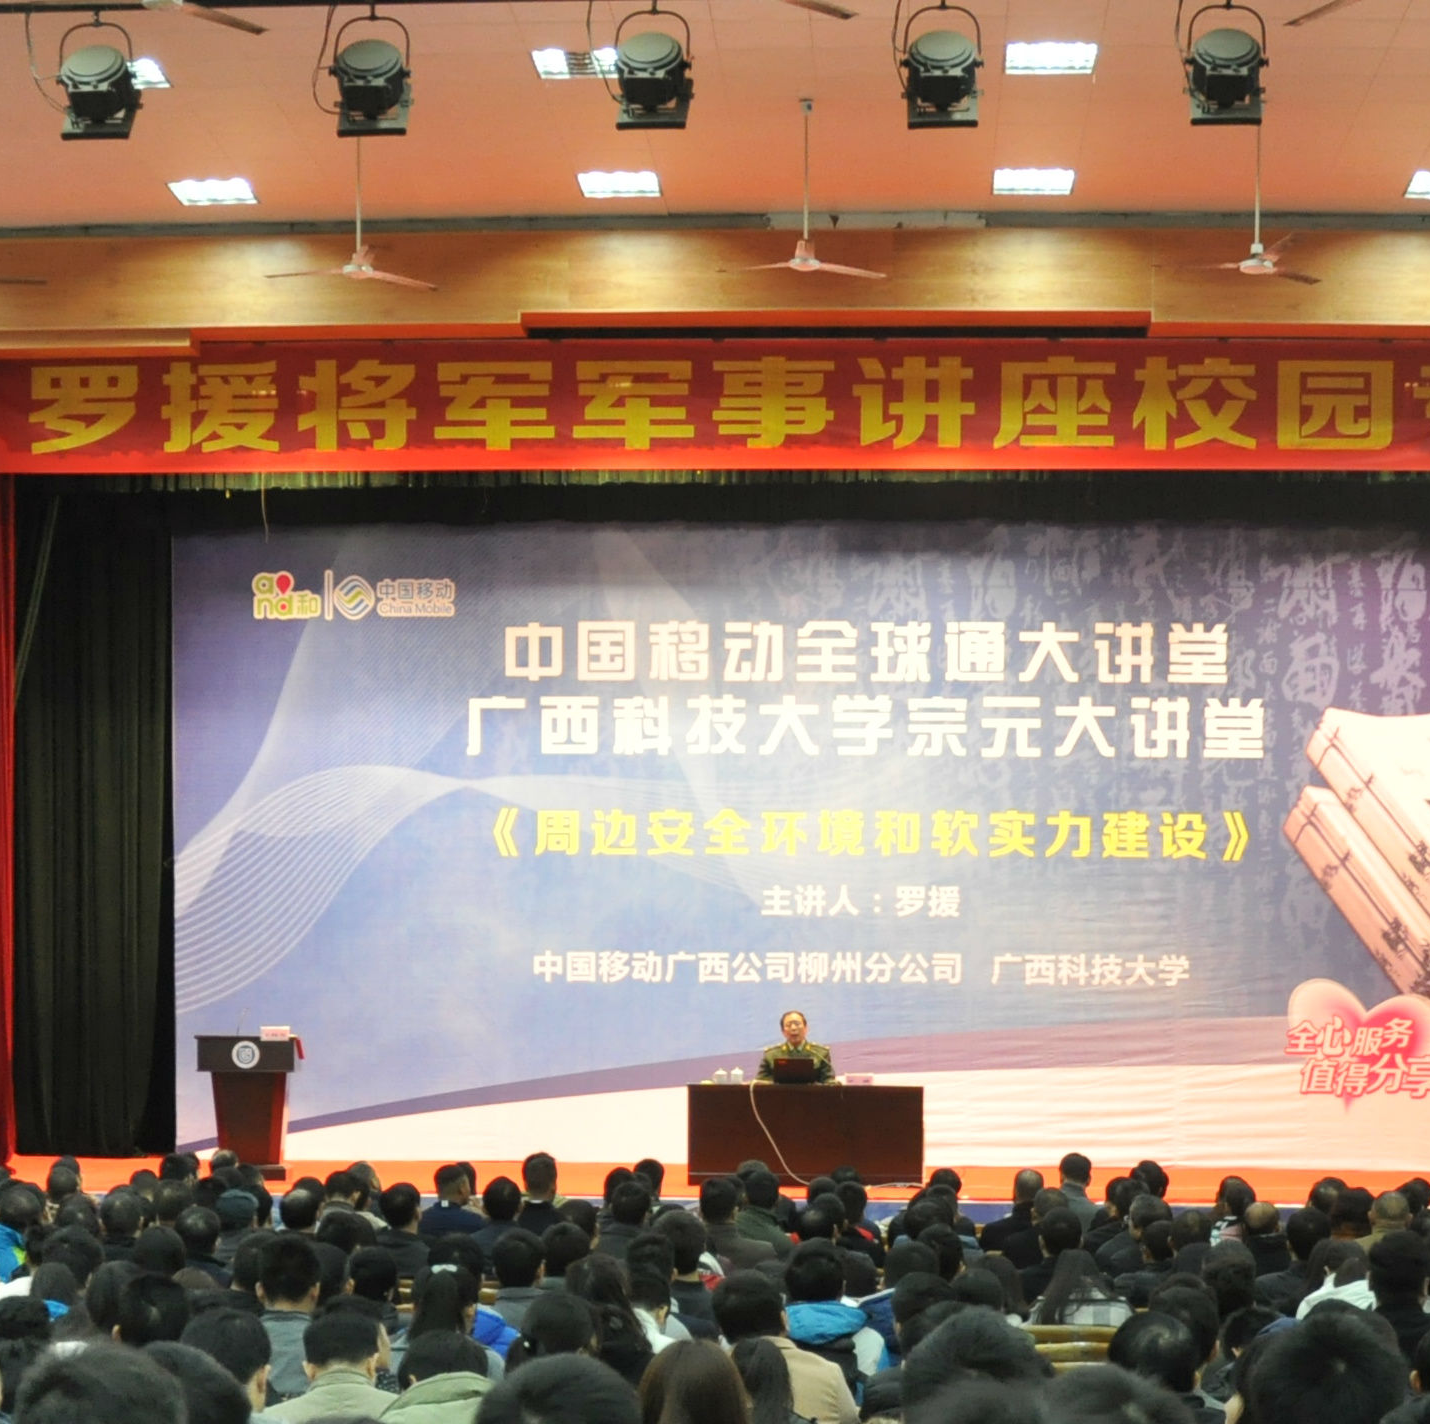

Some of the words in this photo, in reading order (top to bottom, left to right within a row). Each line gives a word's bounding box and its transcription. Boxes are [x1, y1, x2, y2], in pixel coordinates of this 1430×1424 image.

[378, 579, 454, 600] 中国移动
[379, 603, 412, 614] China
[414, 603, 453, 614] Mobile
[503, 619, 1229, 684] 中国移动全球通大讲堂
[466, 693, 1265, 760] 广西科技大学宗元大讲堂
[492, 806, 1250, 862] 《周边安全环境和软实力建设》
[532, 950, 963, 985] 中国移动广西公司柳州分公司
[991, 953, 1190, 986] 广西科技大学
[1284, 1015, 1414, 1057] 全心服务
